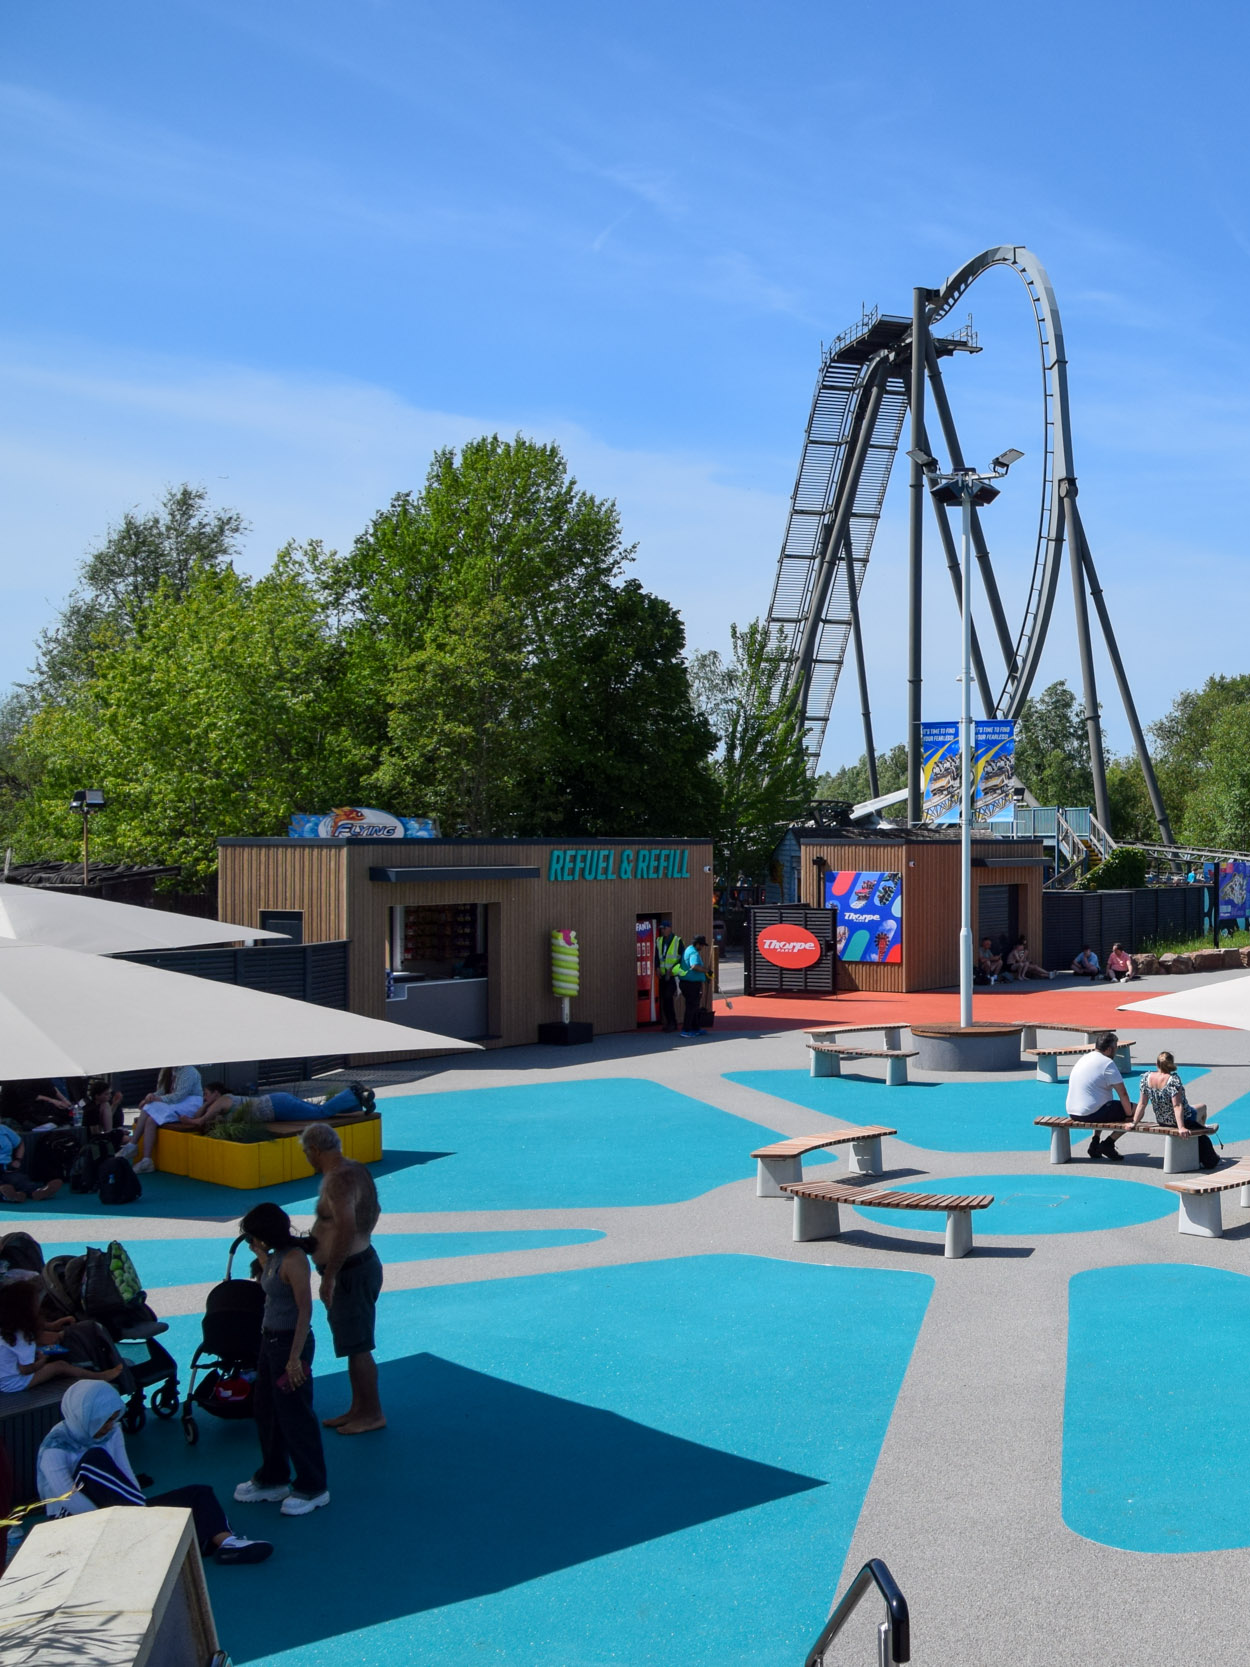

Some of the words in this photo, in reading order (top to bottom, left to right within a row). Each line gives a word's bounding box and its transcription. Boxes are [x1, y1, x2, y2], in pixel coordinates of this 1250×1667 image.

[334, 823, 398, 837] FLYING
[548, 849, 617, 881] REFUEL
[619, 849, 633, 879] &
[635, 849, 690, 879] REFILL
[844, 912, 880, 922] Thorpe
[636, 921, 651, 932] FANTA
[763, 939, 816, 953] Thorpe
